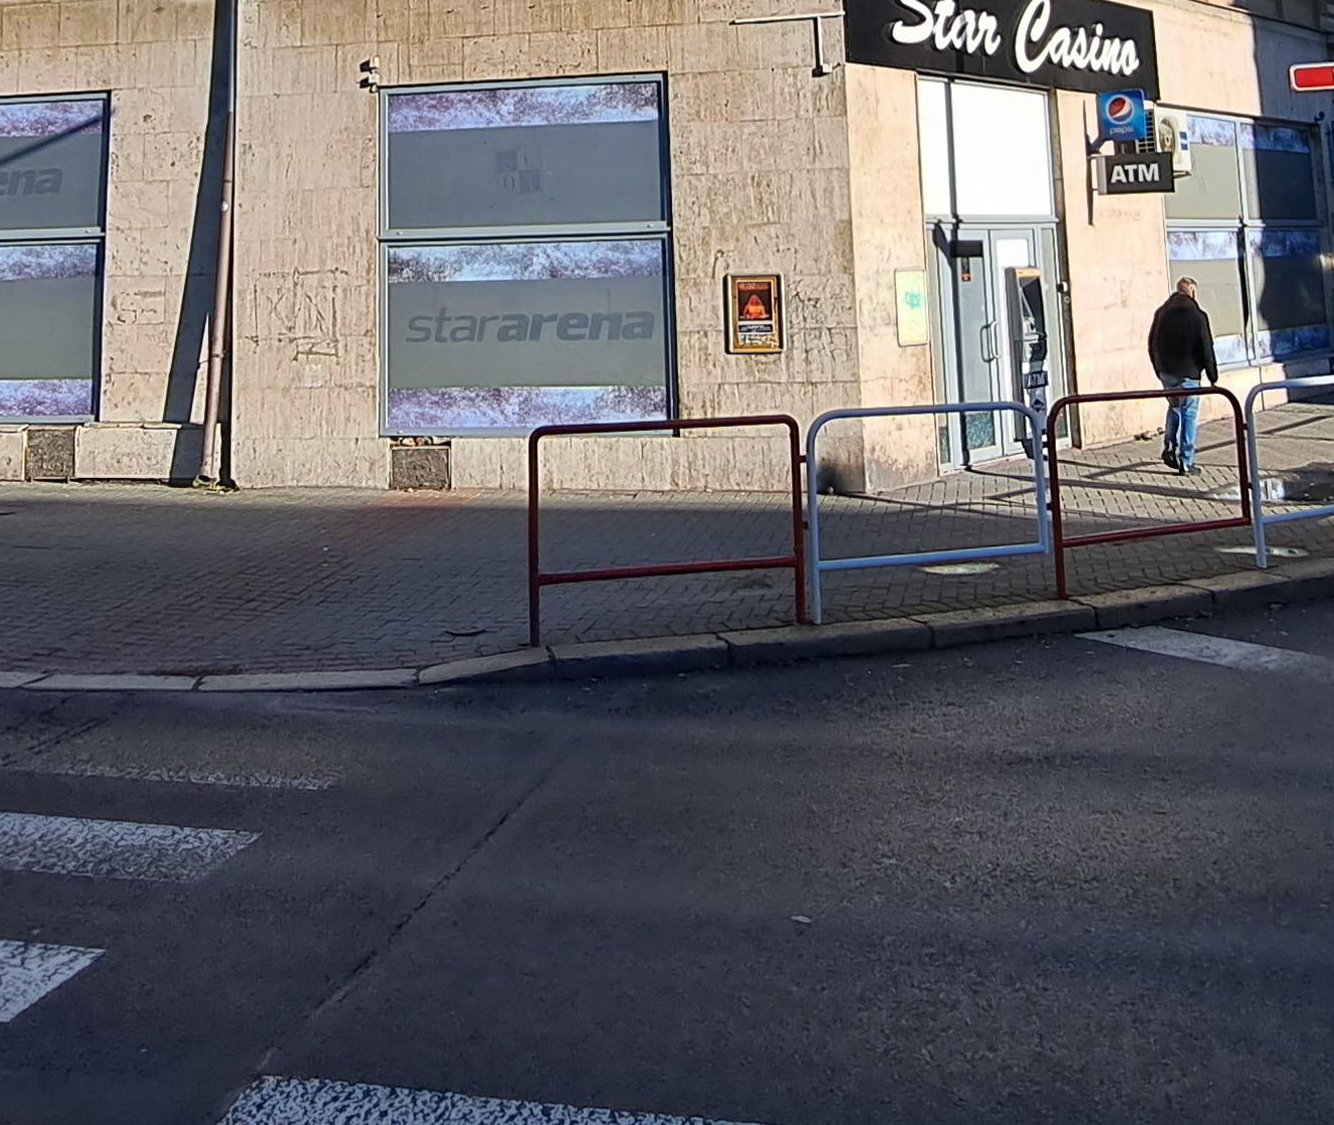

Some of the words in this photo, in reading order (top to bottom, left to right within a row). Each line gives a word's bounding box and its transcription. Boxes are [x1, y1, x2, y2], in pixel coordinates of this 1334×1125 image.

[1109, 126, 1134, 135] pepsi
[1110, 163, 1160, 183] ATM
[405, 307, 655, 343] stararena
